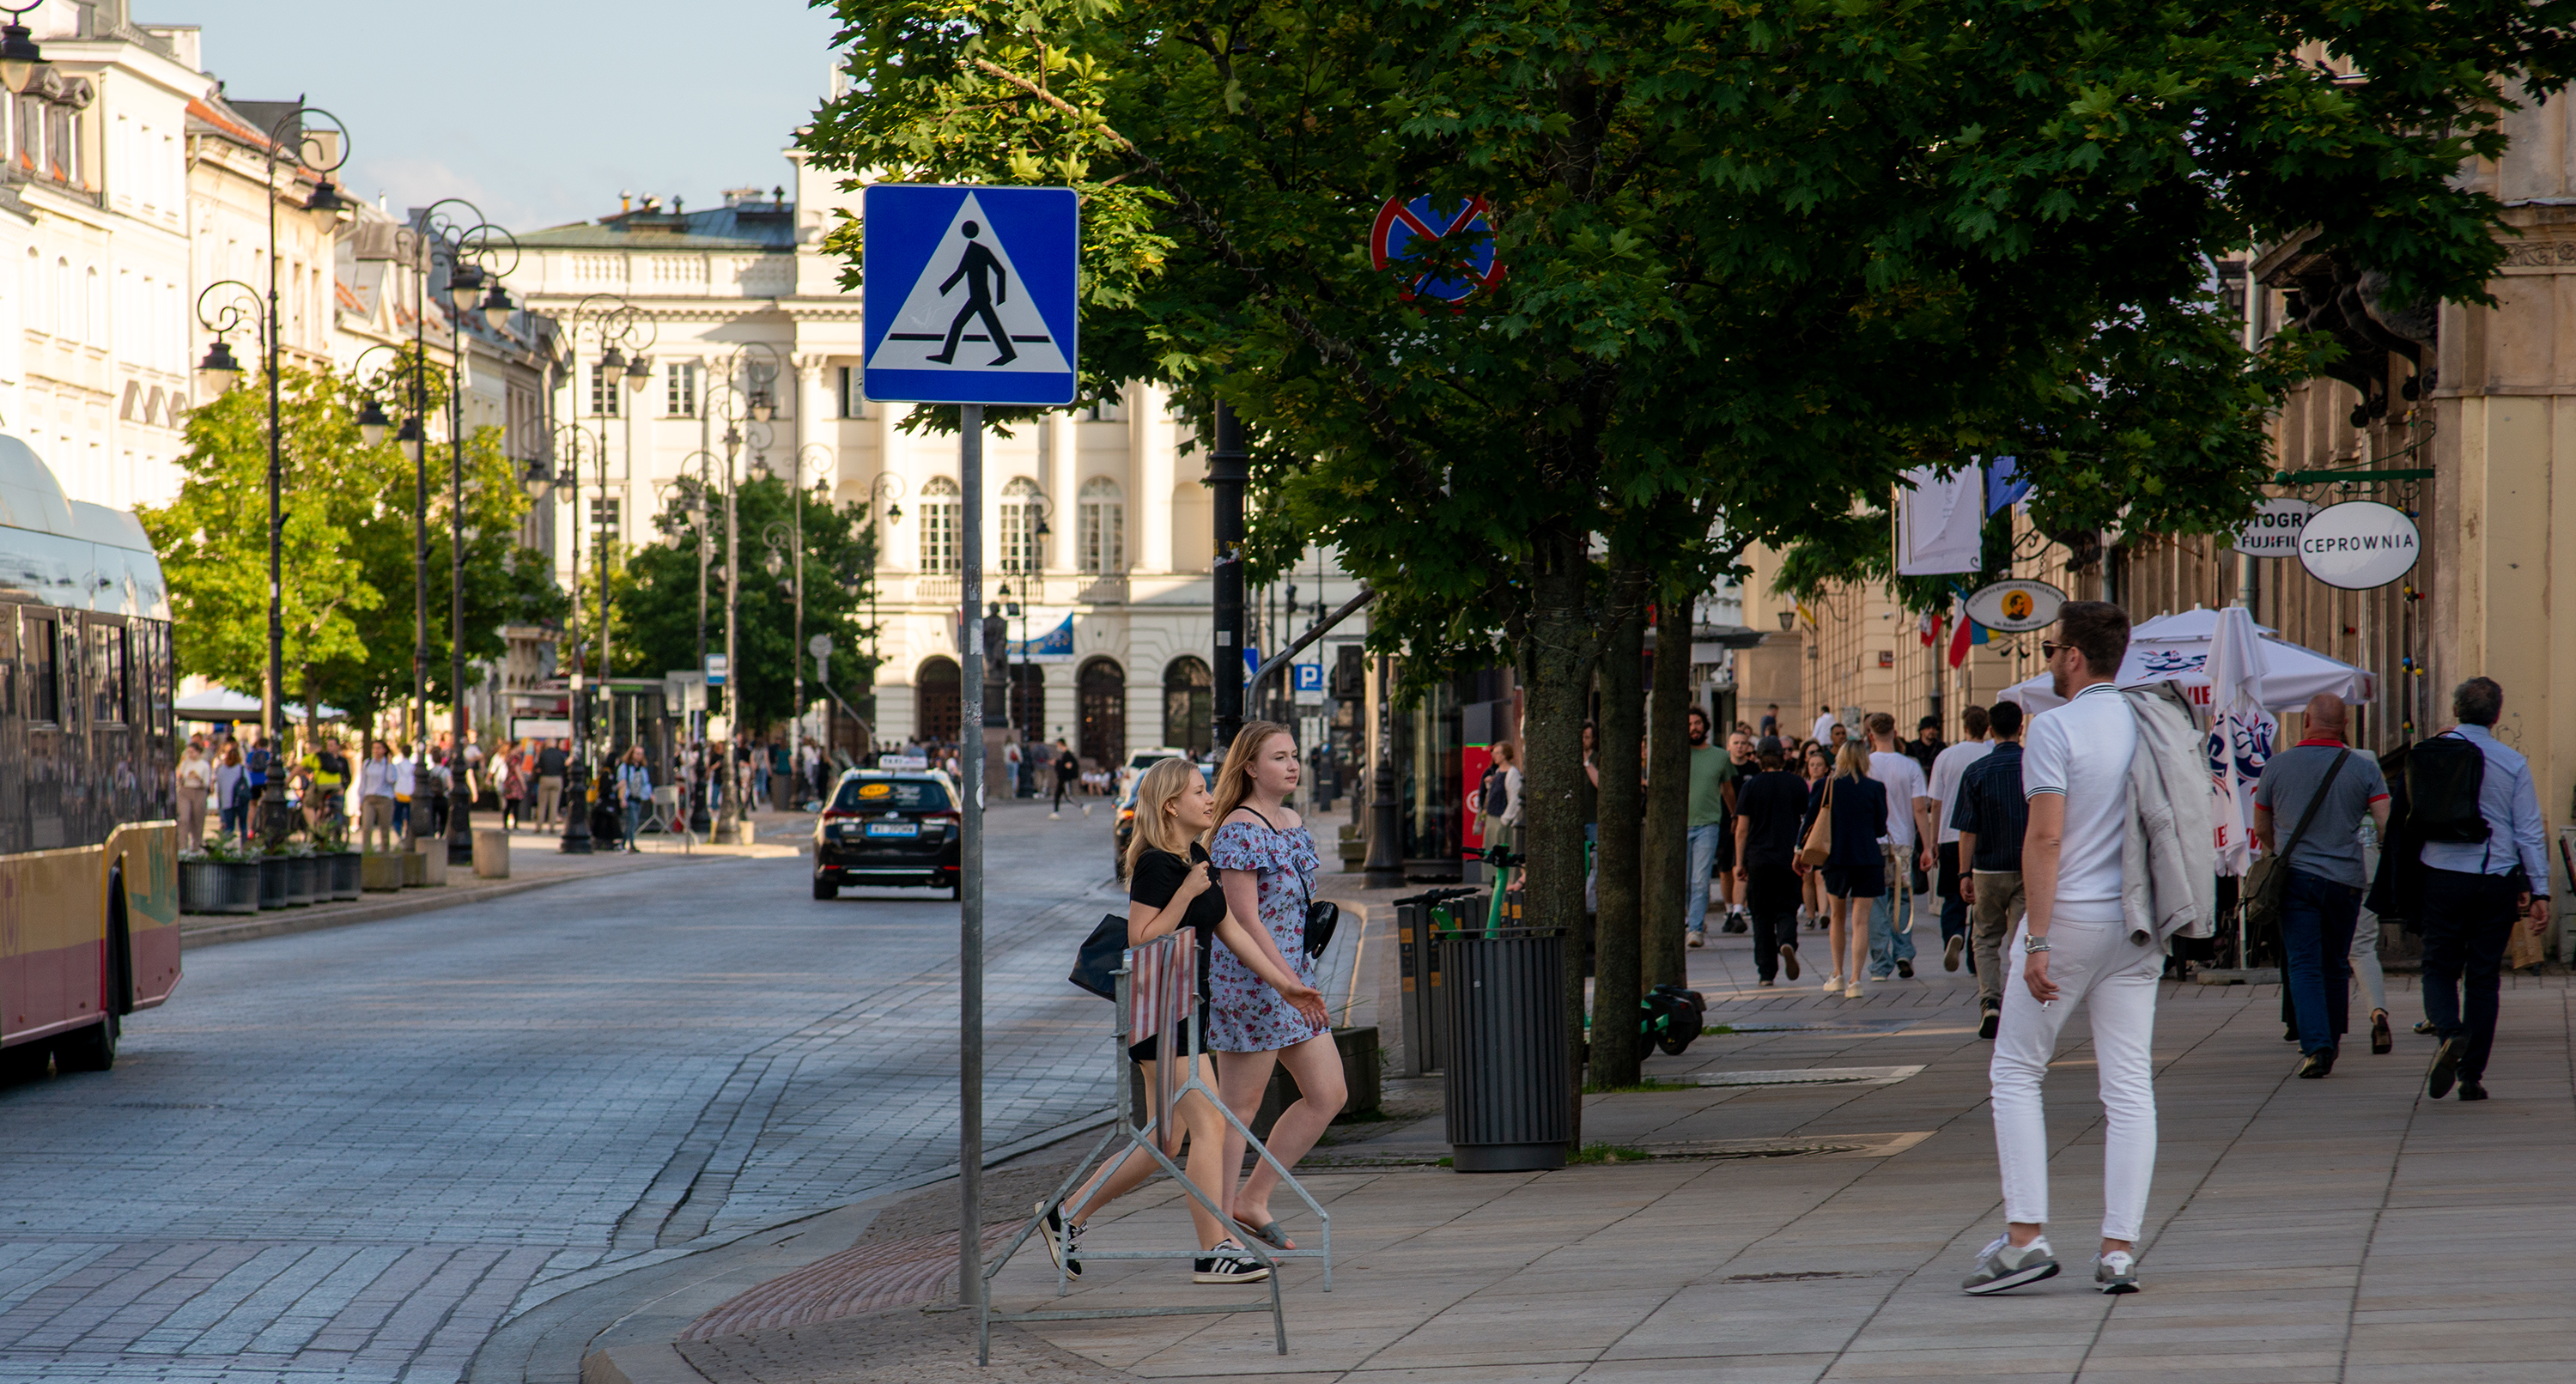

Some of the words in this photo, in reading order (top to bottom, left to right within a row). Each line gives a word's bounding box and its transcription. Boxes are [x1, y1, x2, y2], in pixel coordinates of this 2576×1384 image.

[2242, 536, 2296, 548] FUJIFIL
[2304, 534, 2414, 553] CEPROWNIA
[1301, 666, 1318, 688] P
